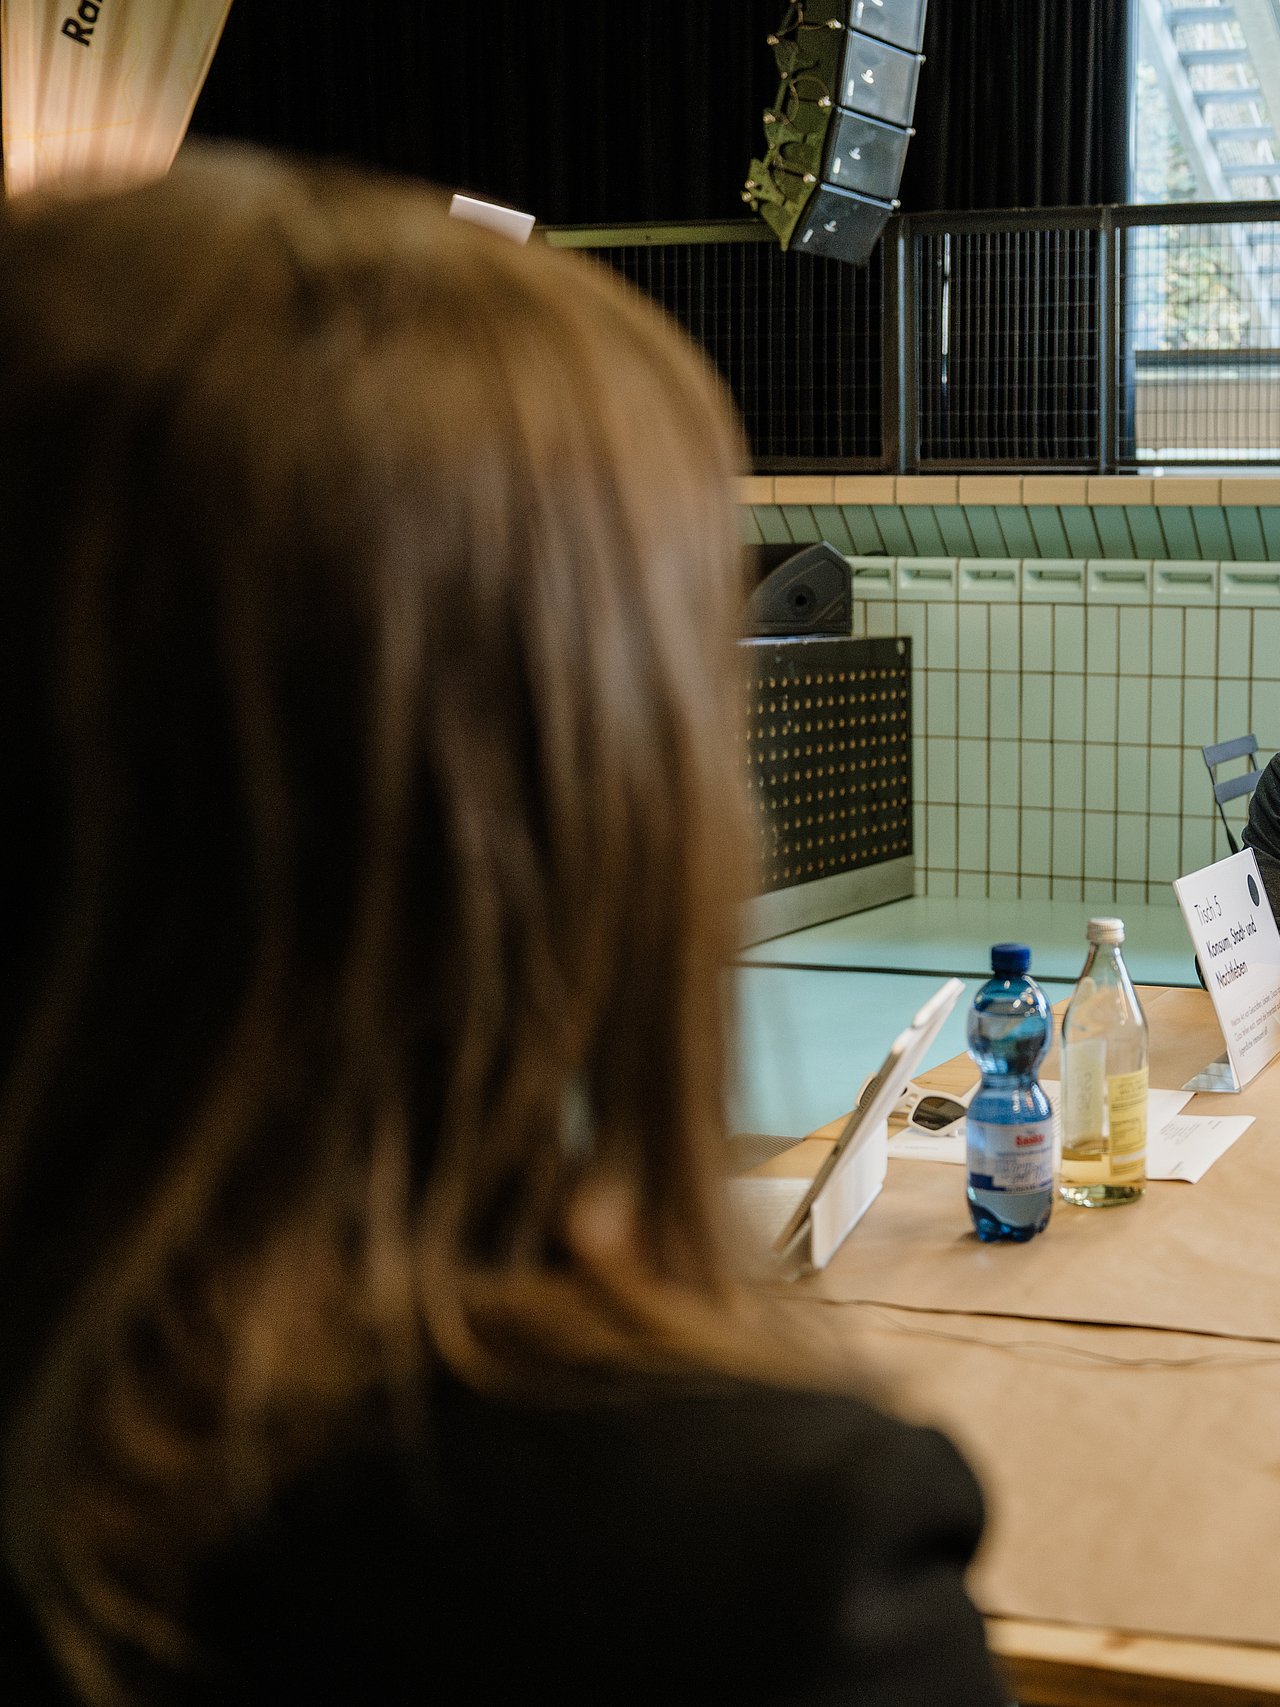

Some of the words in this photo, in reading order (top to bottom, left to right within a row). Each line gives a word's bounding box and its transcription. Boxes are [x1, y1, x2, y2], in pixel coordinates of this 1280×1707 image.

[61, 0, 102, 46] Ra
[1194, 897, 1216, 926] Tisch
[1214, 895, 1223, 916] 5
[1206, 937, 1234, 959] Konsum,
[1230, 921, 1246, 945] Stadt-
[1245, 914, 1257, 936] und
[1215, 958, 1249, 990] Nachtleben
